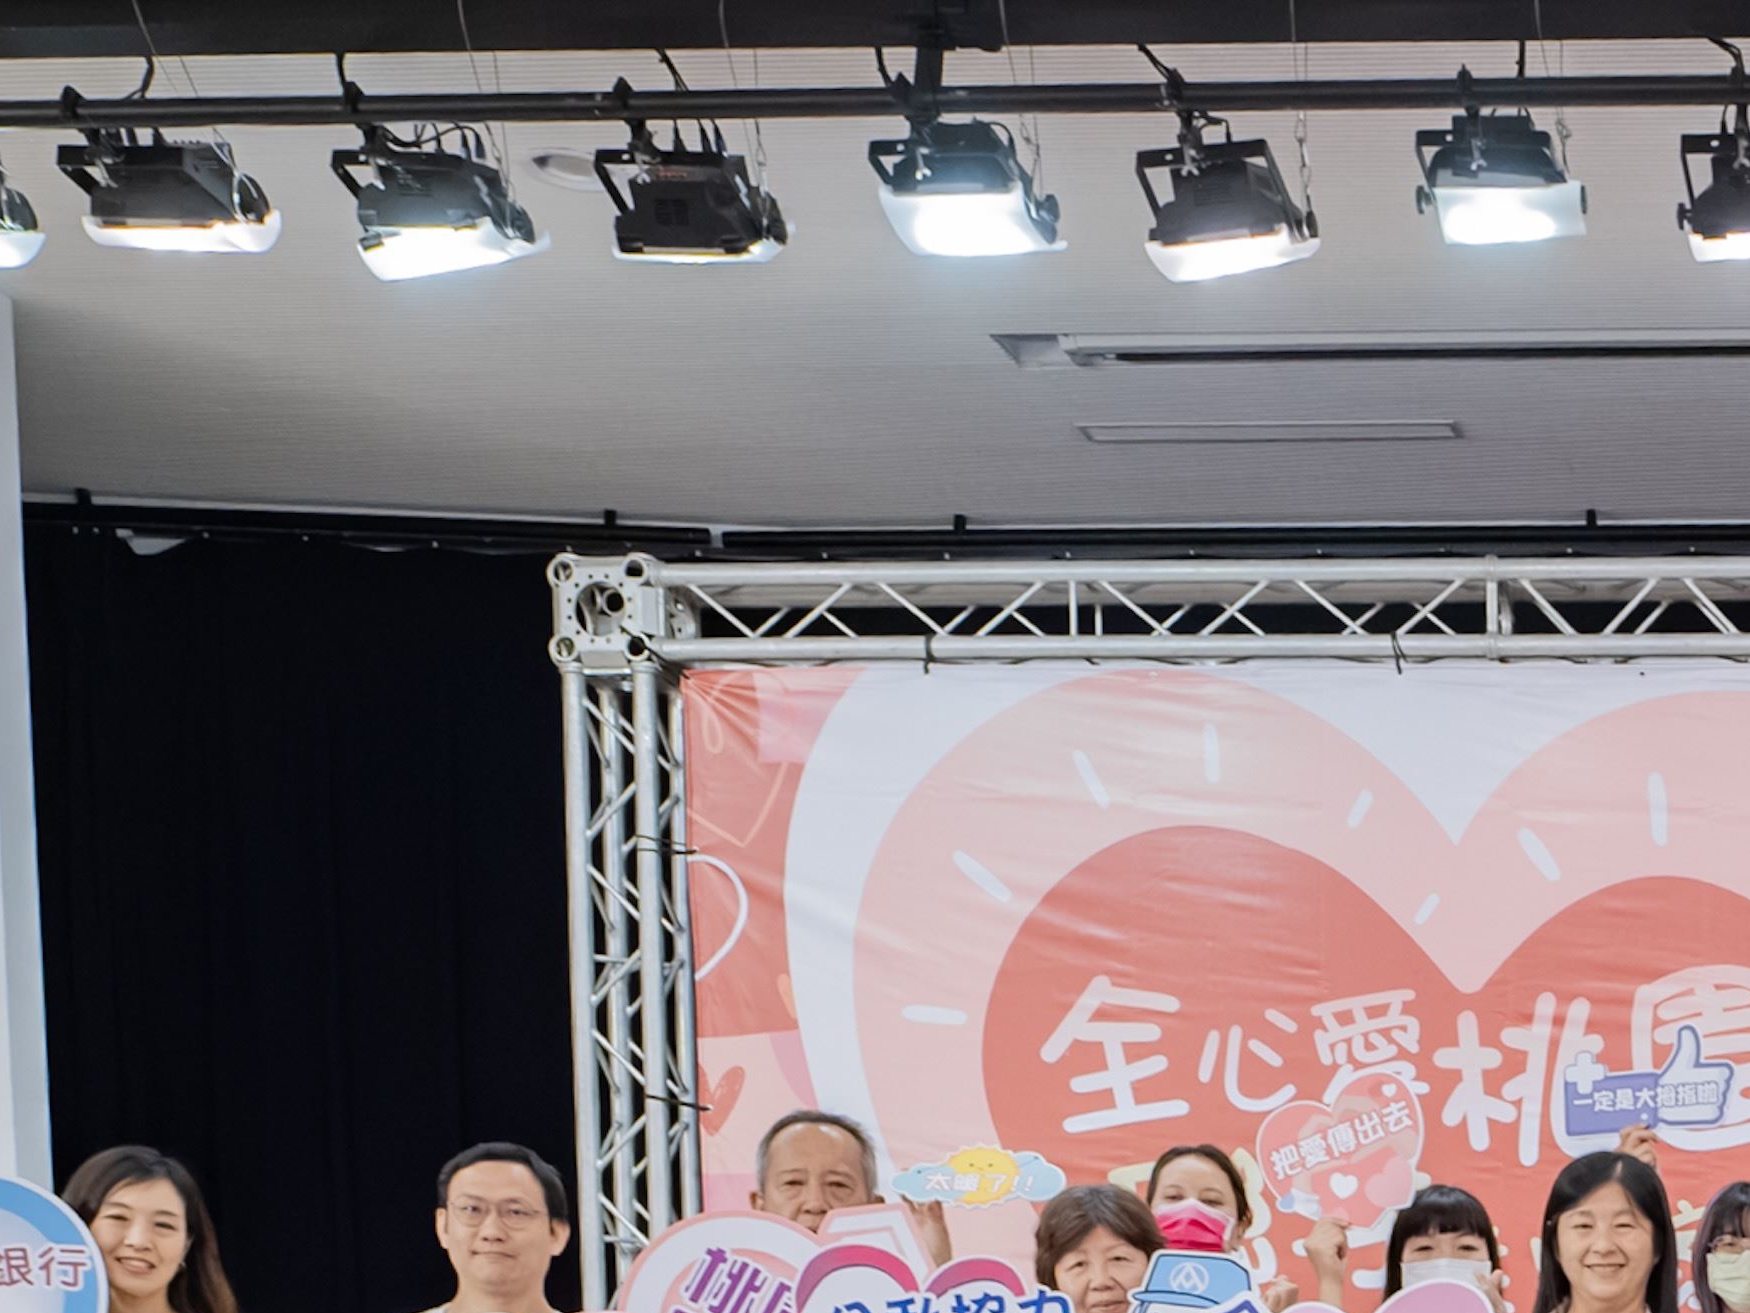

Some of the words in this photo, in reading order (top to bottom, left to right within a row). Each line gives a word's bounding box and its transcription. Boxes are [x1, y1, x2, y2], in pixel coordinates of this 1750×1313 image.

[1269, 1100, 1414, 1180] 把愛傳出去
